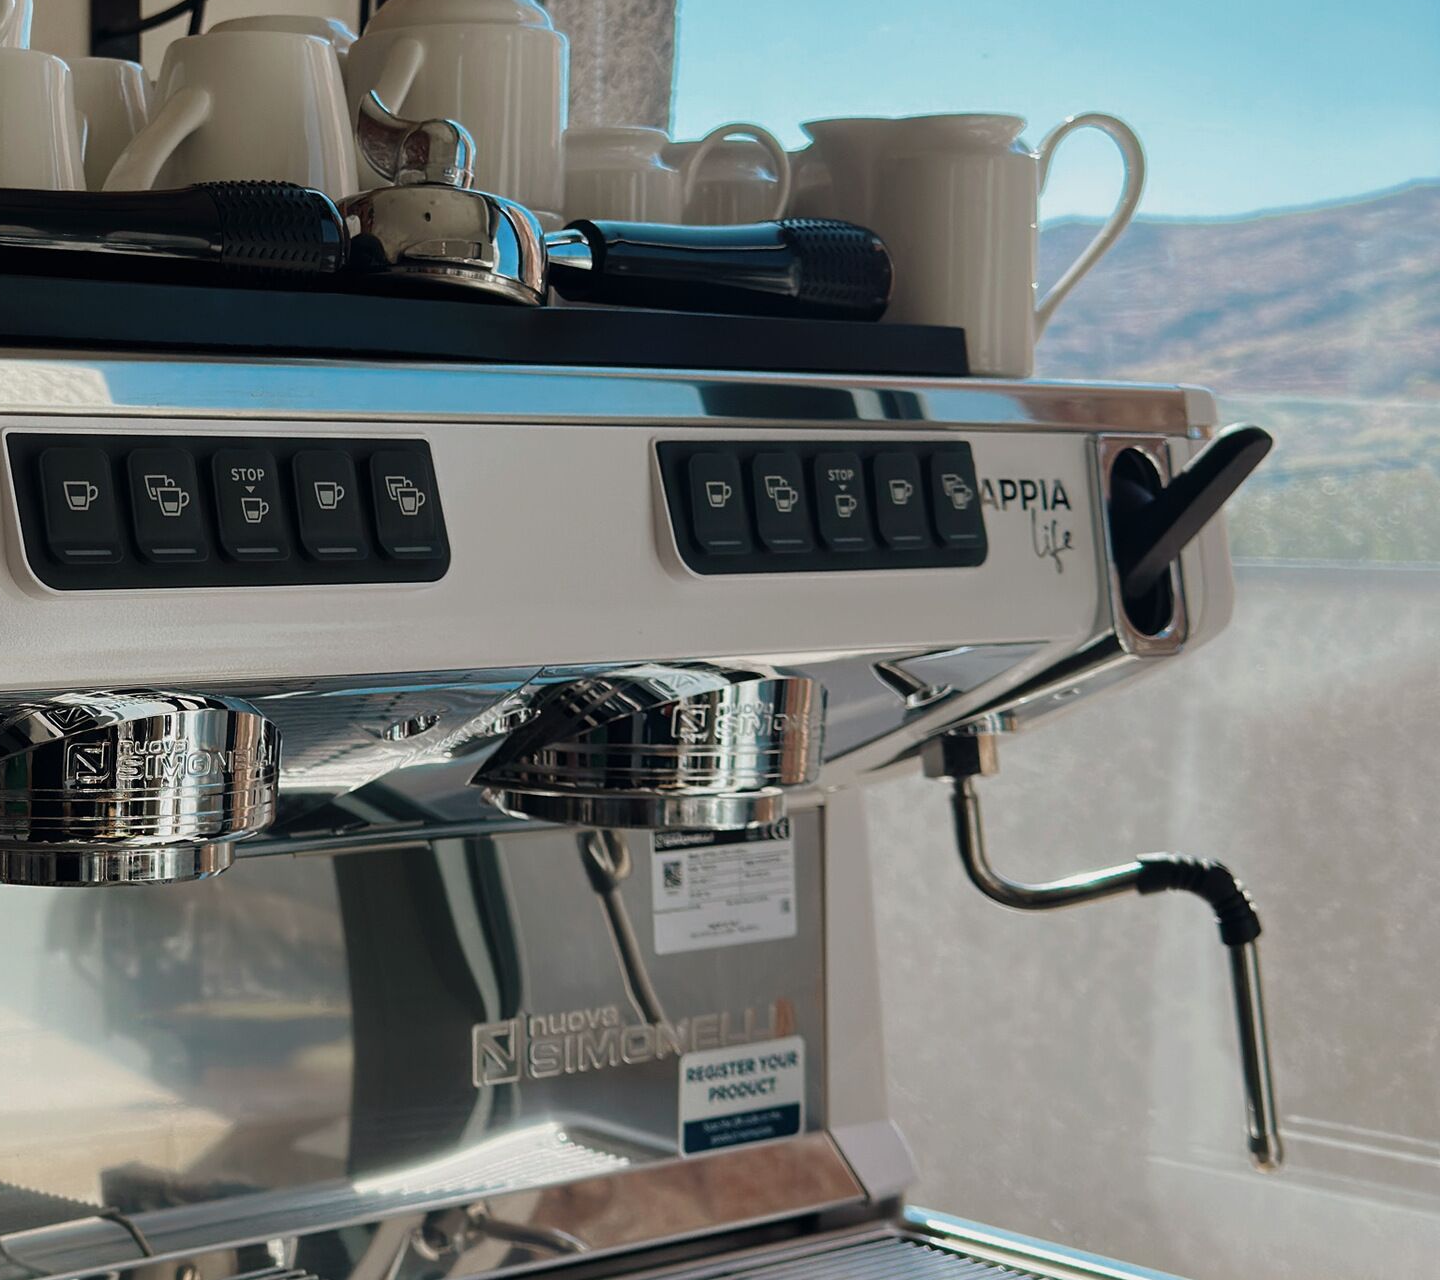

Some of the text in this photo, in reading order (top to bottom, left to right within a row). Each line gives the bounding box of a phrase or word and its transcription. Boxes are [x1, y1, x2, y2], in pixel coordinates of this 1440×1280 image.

[230, 467, 265, 482] STOP
[827, 468, 854, 482] STOP
[980, 478, 1071, 512] APPIA
[1031, 508, 1075, 573] life
[119, 738, 189, 755] nuova
[528, 1004, 620, 1037] nuova
[528, 997, 796, 1078] SIMONELLI
[686, 1050, 799, 1083] REGISTER YOUR
[708, 1077, 777, 1102] PRODUCT
